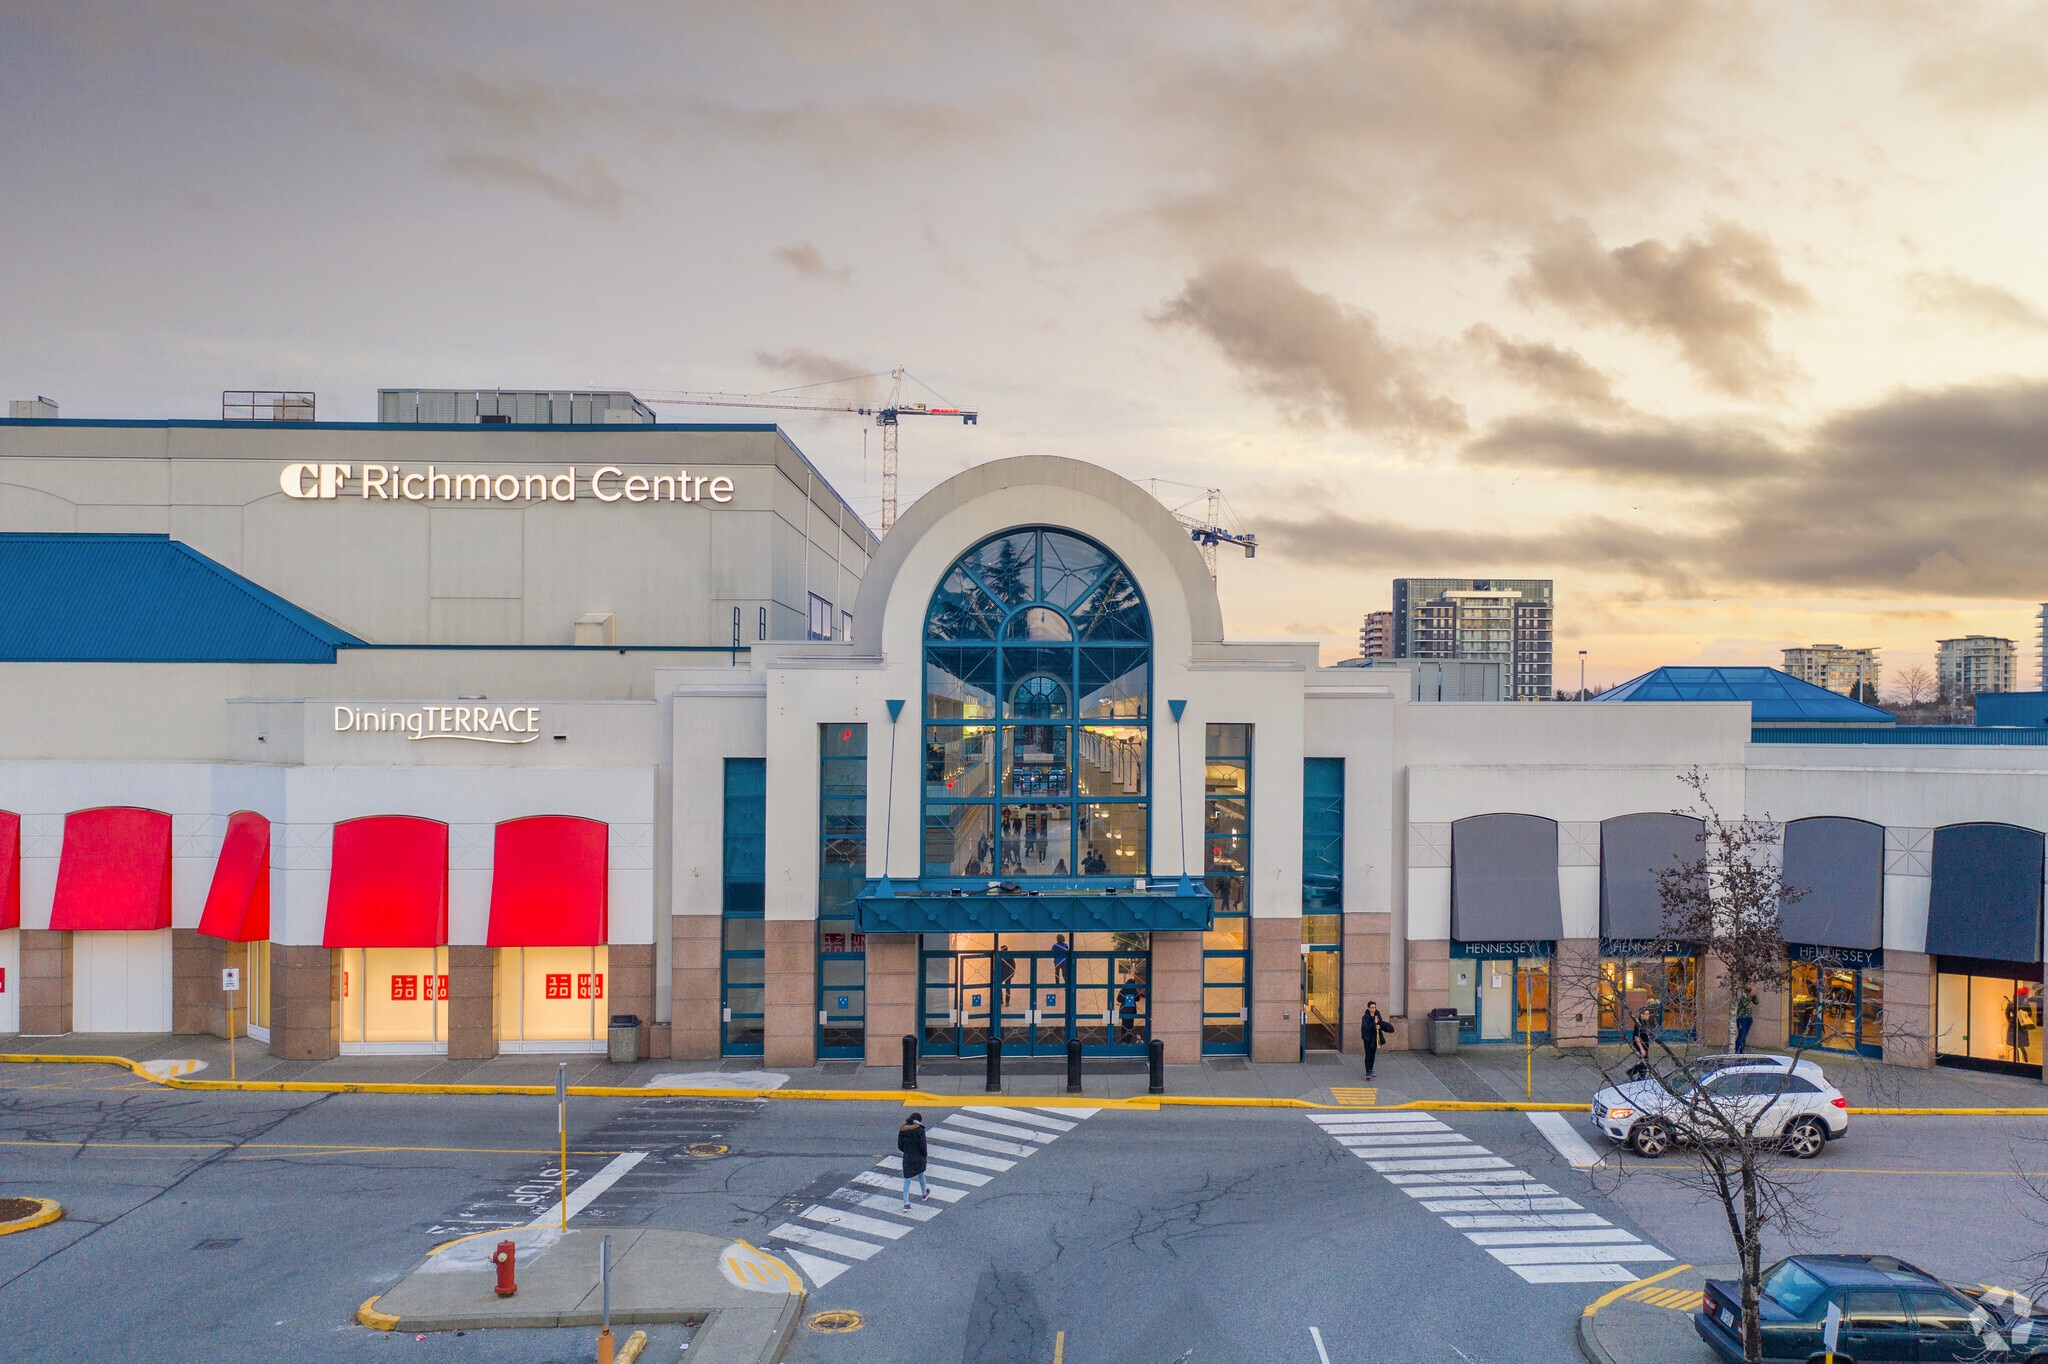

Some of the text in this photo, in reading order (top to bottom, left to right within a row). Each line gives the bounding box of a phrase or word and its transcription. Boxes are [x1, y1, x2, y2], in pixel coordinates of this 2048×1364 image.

[280, 463, 736, 503] CF Richmond Centre
[1465, 943, 1534, 954] HENNESSEY
[1613, 942, 1680, 953] HENNSEY
[507, 1168, 580, 1204] STOP
